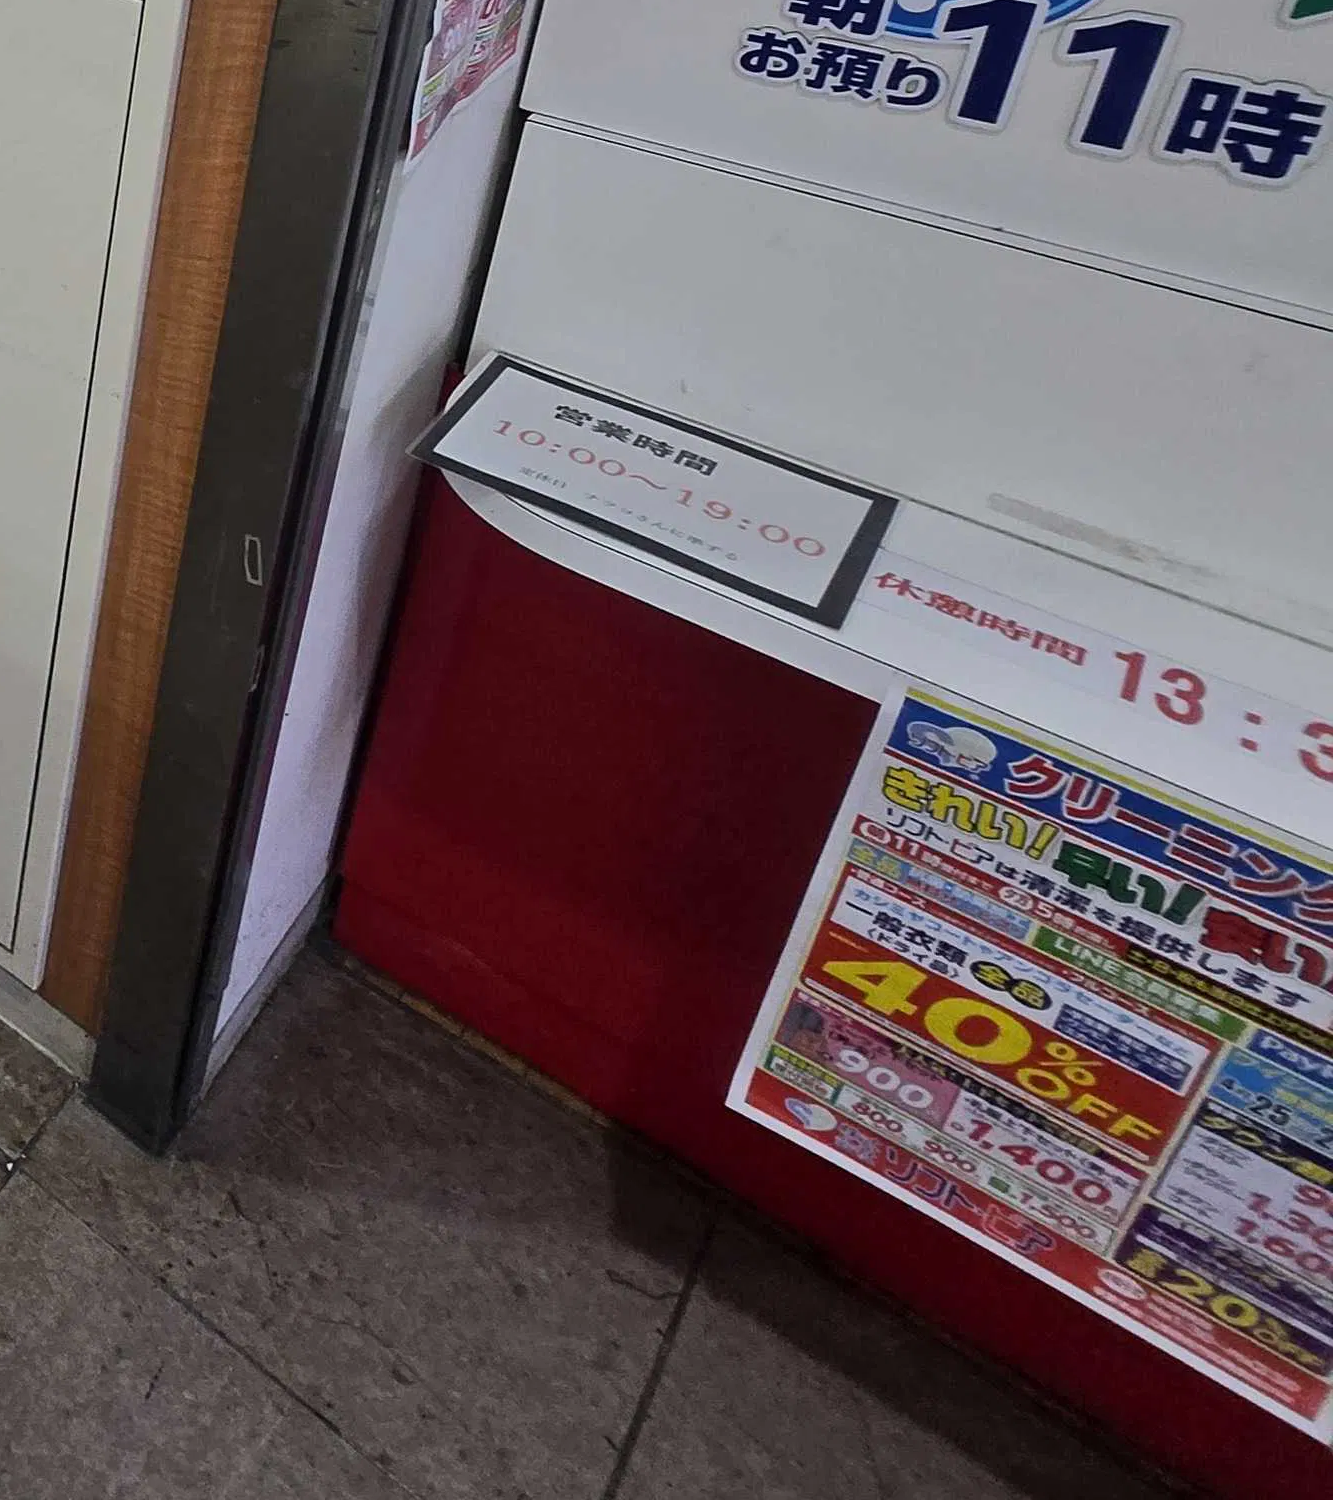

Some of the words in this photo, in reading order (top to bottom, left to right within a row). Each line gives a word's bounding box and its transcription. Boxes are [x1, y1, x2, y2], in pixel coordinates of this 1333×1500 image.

[739, 34, 942, 108] お預り
[550, 402, 721, 478] 営業時間
[489, 417, 829, 562] 10:00～19:00
[873, 569, 1088, 668] 休憩時間
[875, 760, 1059, 864] きれい!
[1046, 835, 1208, 933] 早い!
[840, 894, 972, 969] 一般衣類
[833, 1044, 937, 1115] 900
[962, 1114, 1117, 1213] 1,400
[849, 1097, 905, 1137] 800
[920, 1137, 979, 1178] 900
